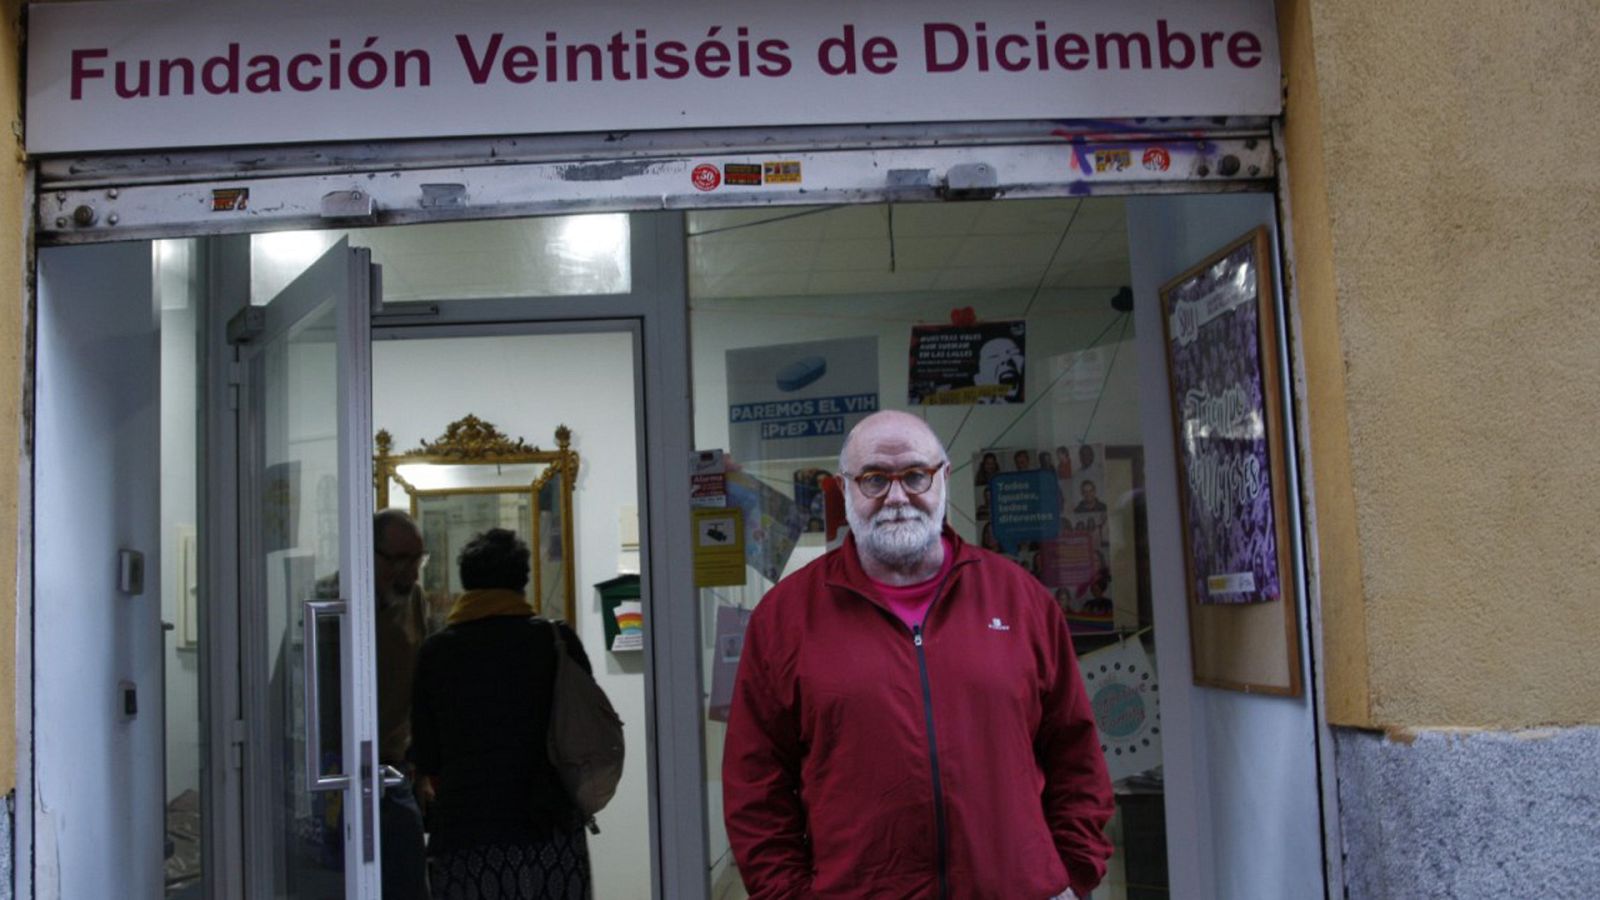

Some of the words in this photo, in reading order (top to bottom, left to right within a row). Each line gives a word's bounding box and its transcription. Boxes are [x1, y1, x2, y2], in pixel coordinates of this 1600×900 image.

[71, 37, 431, 100] Fundación
[457, 25, 791, 84] Veintiséis
[819, 24, 898, 77] de
[924, 21, 1260, 73] Diciembre
[731, 401, 815, 421] PAREMOS
[819, 398, 841, 414] EL
[845, 395, 876, 411] VIH
[762, 420, 809, 438] ¡PrEP
[813, 418, 843, 434] YA!
